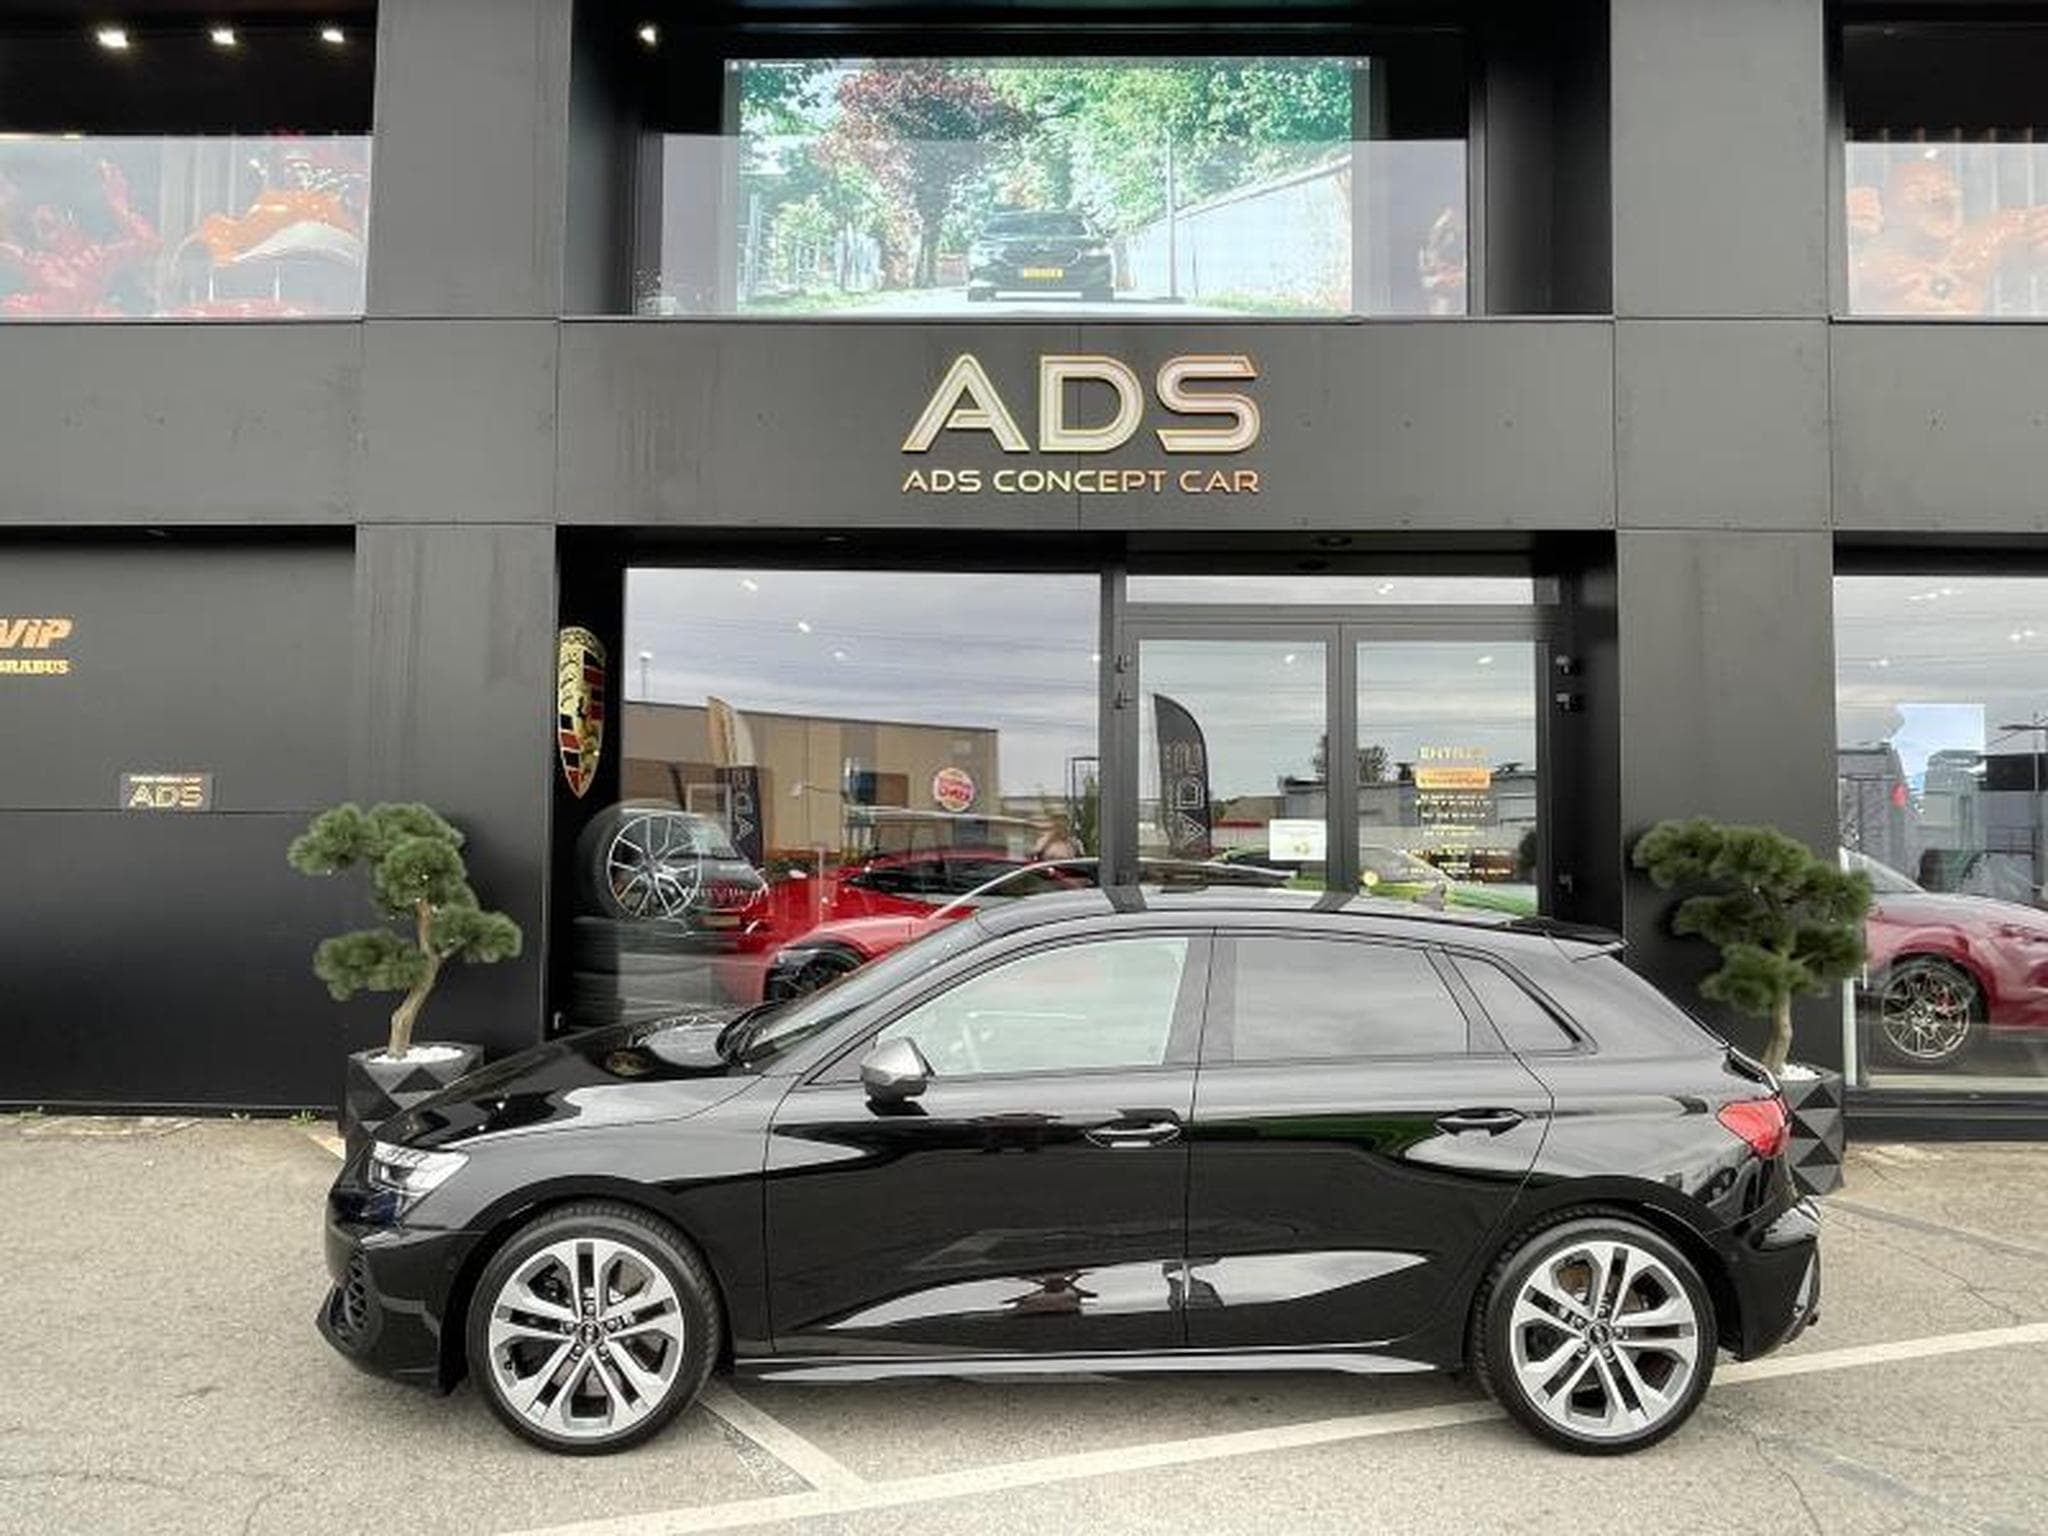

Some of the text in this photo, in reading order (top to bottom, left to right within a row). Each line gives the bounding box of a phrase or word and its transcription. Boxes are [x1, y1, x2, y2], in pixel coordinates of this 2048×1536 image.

[902, 353, 1261, 454] ADS
[902, 469, 1260, 493] ADS CONCEPT CAR
[129, 785, 203, 807] ADS
